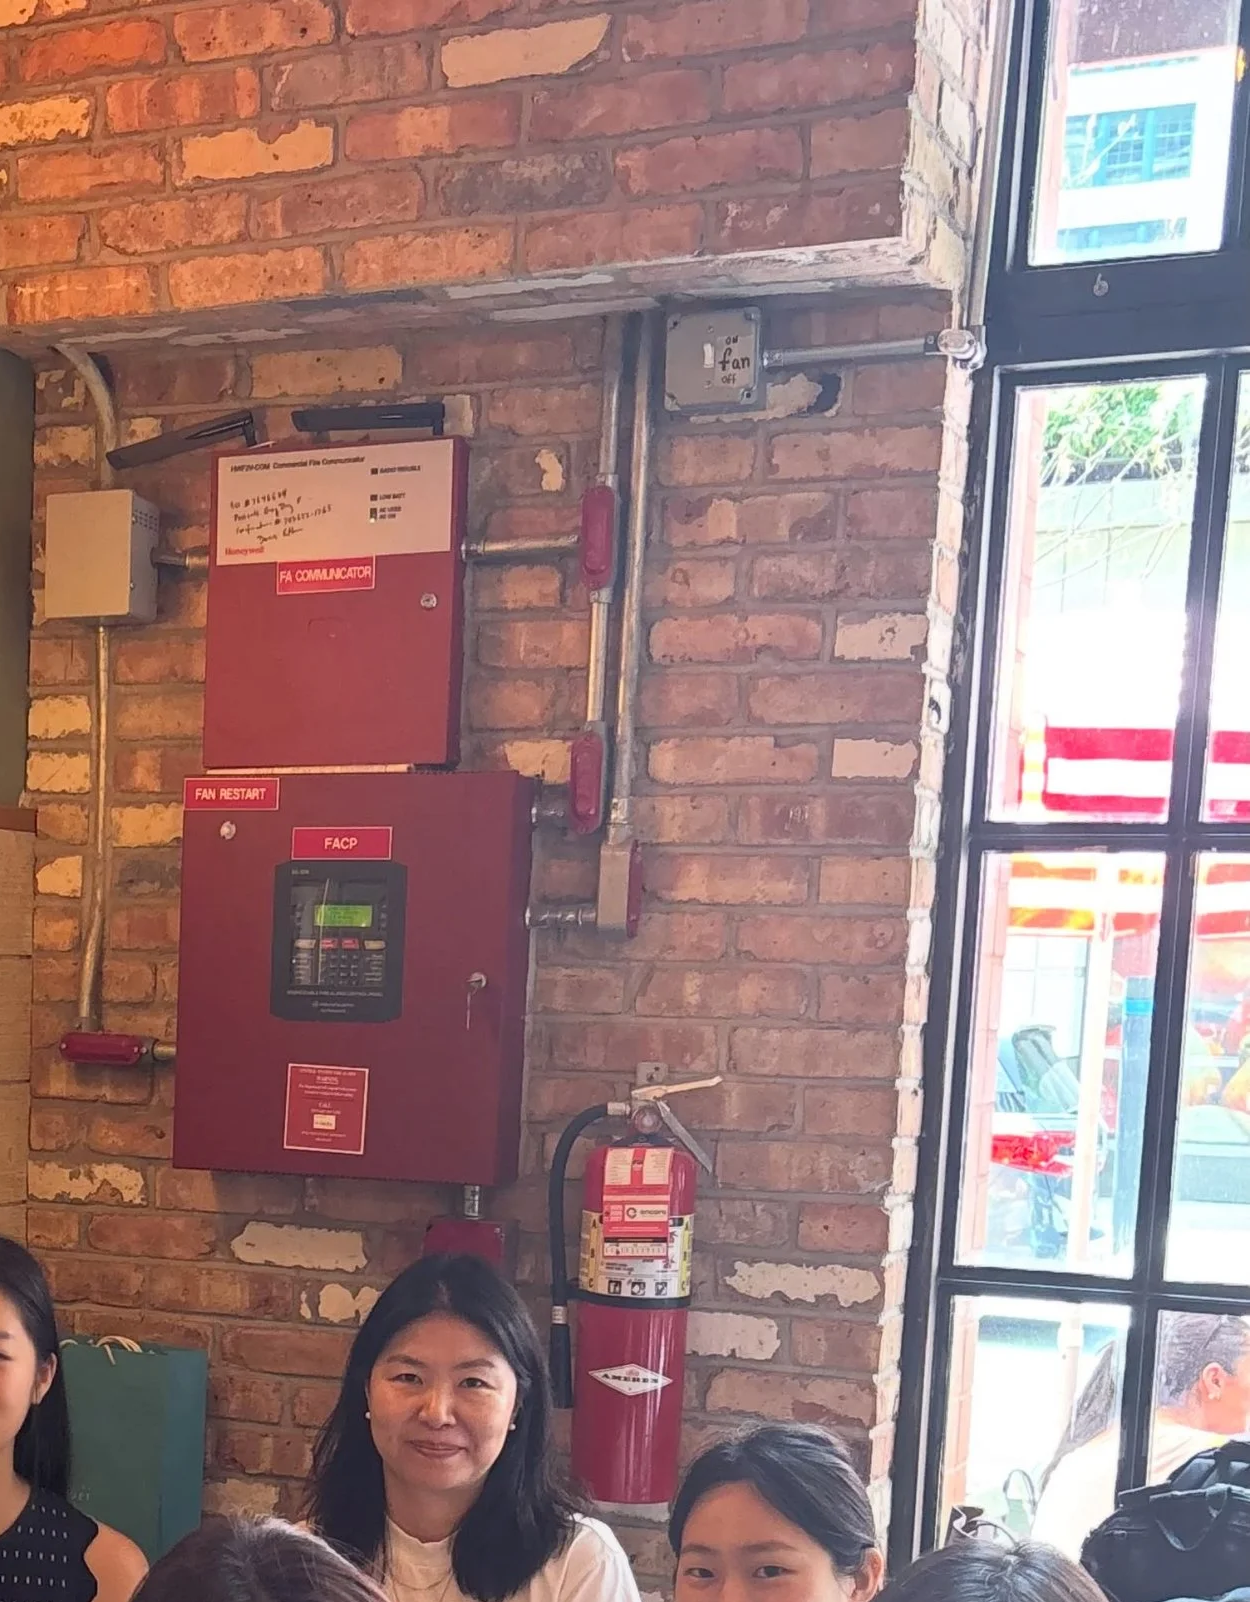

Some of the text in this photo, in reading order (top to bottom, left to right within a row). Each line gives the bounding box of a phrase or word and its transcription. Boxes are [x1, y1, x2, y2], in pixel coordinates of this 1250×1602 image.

[718, 346, 751, 372] fan
[279, 565, 372, 584] FA COMMUNICATOR
[195, 787, 267, 801] FAN RESTART
[324, 836, 359, 850] FACP
